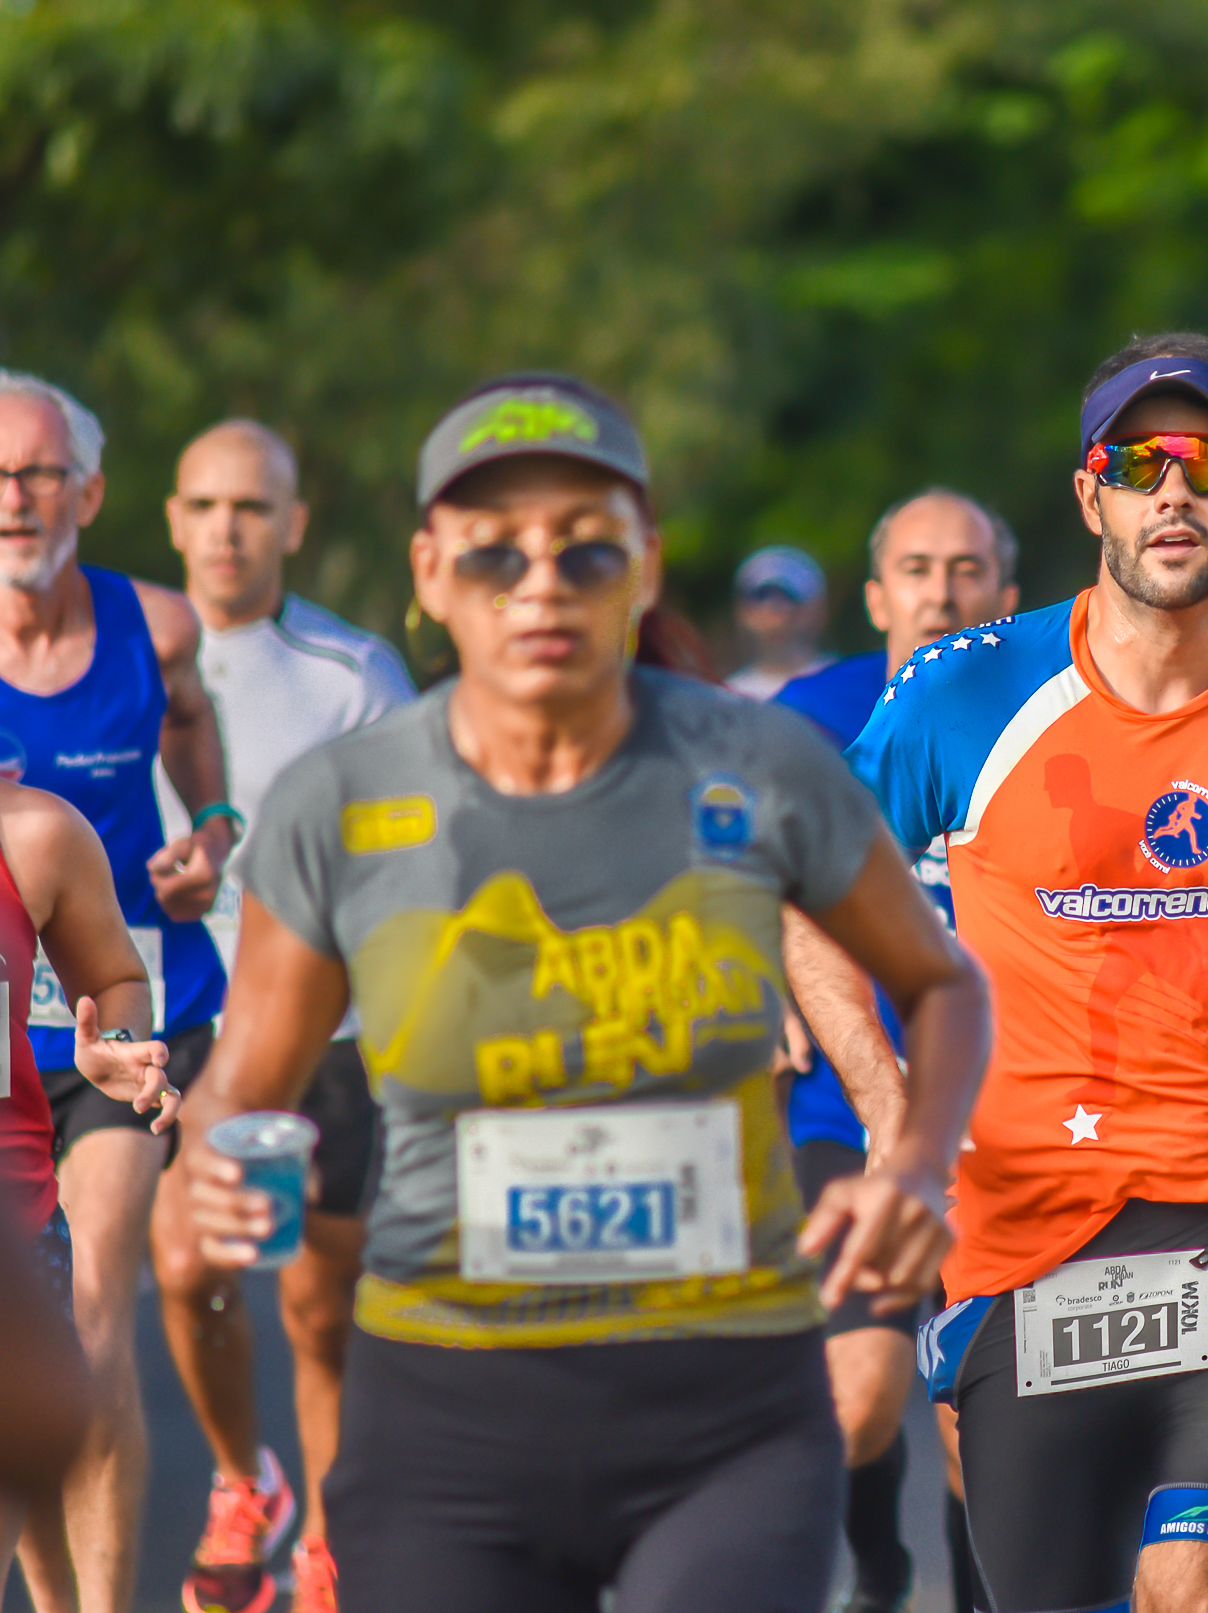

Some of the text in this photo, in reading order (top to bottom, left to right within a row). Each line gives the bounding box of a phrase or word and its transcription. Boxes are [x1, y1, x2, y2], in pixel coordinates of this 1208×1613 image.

[533, 910, 716, 998] ABDA
[474, 1015, 694, 1102] RUN
[518, 1189, 664, 1248] 5621
[1104, 1264, 1128, 1276] ABDA
[1098, 1279, 1123, 1292] RUN
[1067, 1294, 1102, 1306] bradesco
[1067, 1303, 1093, 1312] corporate
[1181, 1281, 1199, 1335] 10KM
[1062, 1304, 1169, 1362] 1121
[1102, 1358, 1130, 1372] TIAGO
[1160, 1521, 1205, 1535] AMIGOS
